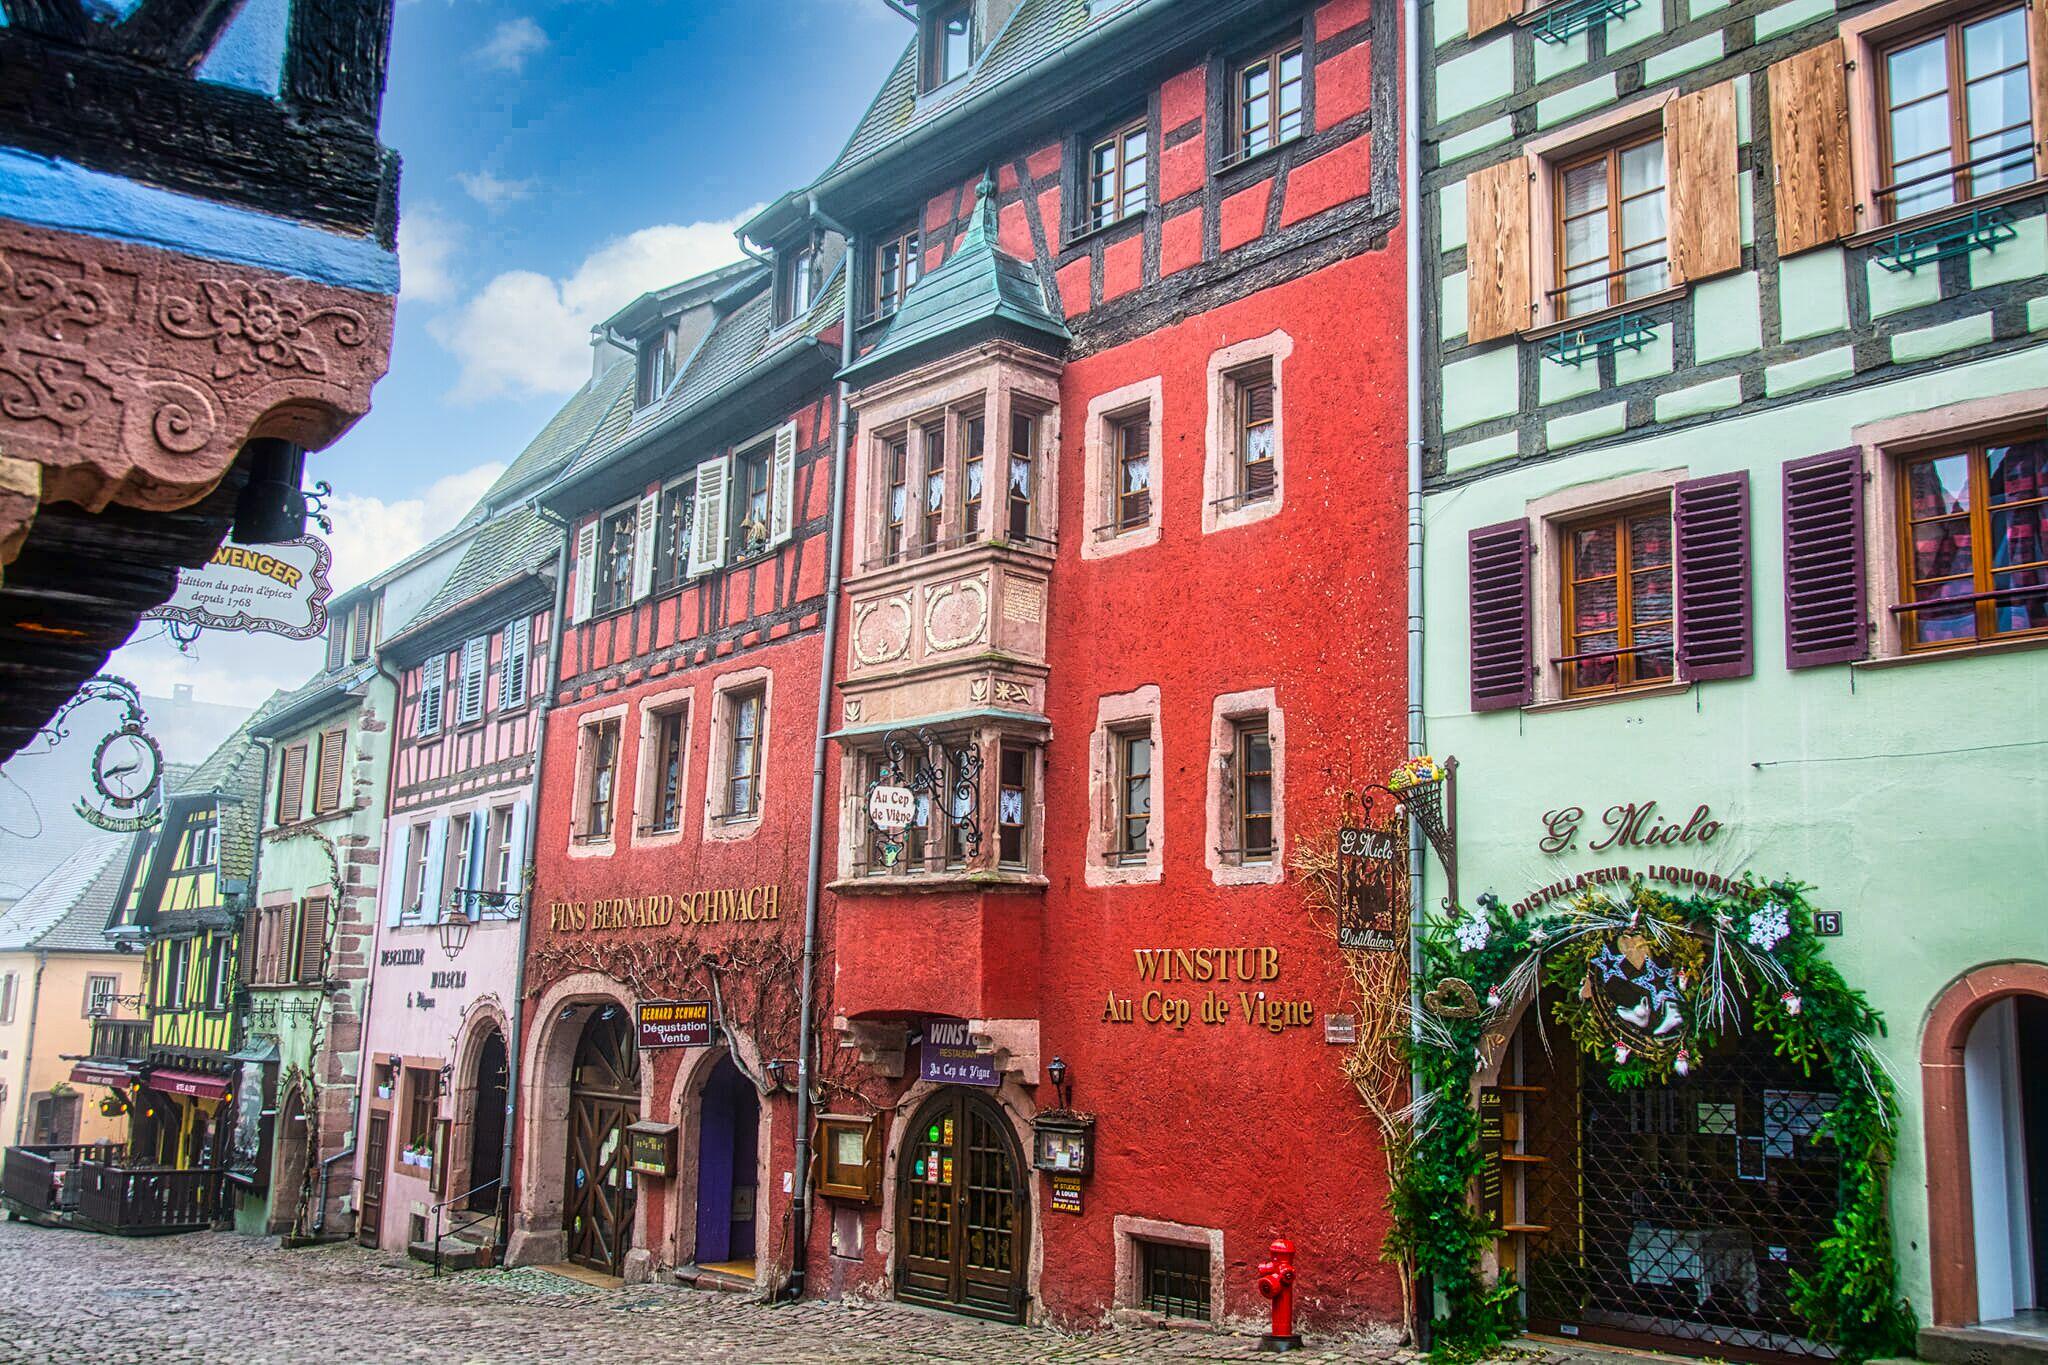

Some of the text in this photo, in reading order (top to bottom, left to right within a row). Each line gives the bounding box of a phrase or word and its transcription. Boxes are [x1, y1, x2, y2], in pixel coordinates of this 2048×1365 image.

[215, 580, 229, 591] du
[230, 584, 254, 595] pain
[256, 586, 293, 599] d'épices
[191, 591, 251, 608] depuis 1768
[875, 790, 909, 808] Au Cep
[872, 808, 911, 824] de Vigne
[1538, 800, 1724, 854] G. Miclo
[1511, 865, 1630, 919] DISTILLATEUR
[1648, 863, 1754, 900] LIQUORIST
[550, 884, 780, 931] VINS BERNARD SCHWACH
[1817, 914, 1837, 933] 15
[1340, 927, 1395, 951] Distillateur
[1133, 947, 1280, 982] WINSTUB
[642, 1005, 707, 1020] BERNARD SCHWACH
[1101, 990, 1314, 1033] Au Cep de Vigne
[643, 1021, 707, 1034] Dégustation
[660, 1033, 690, 1043] Vente
[943, 1063, 956, 1078] Cep
[959, 1065, 967, 1076] de
[969, 1065, 990, 1080] Vigne
